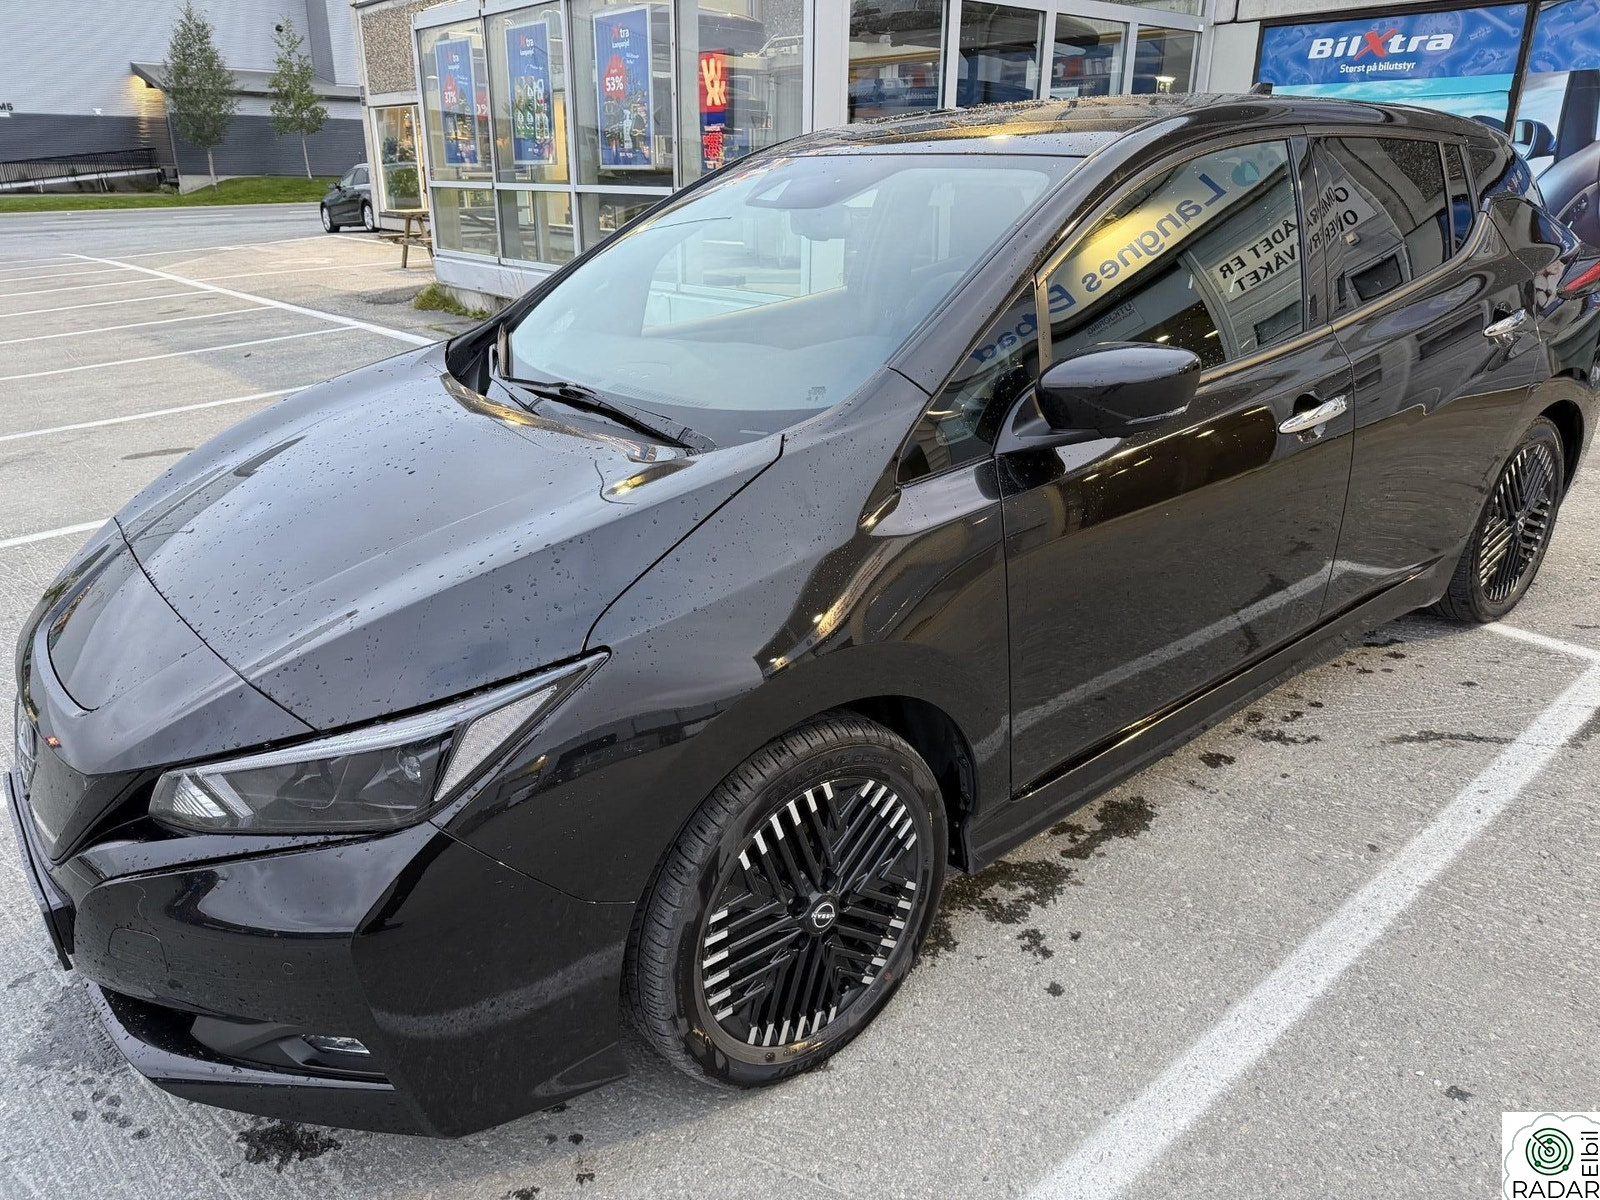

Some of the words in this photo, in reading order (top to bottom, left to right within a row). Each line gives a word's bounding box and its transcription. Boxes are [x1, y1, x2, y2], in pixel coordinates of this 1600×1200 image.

[1307, 28, 1454, 61] BilXtra
[1366, 62, 1377, 74] på
[1378, 61, 1416, 72] bilutstyr
[605, 75, 624, 91] 53%
